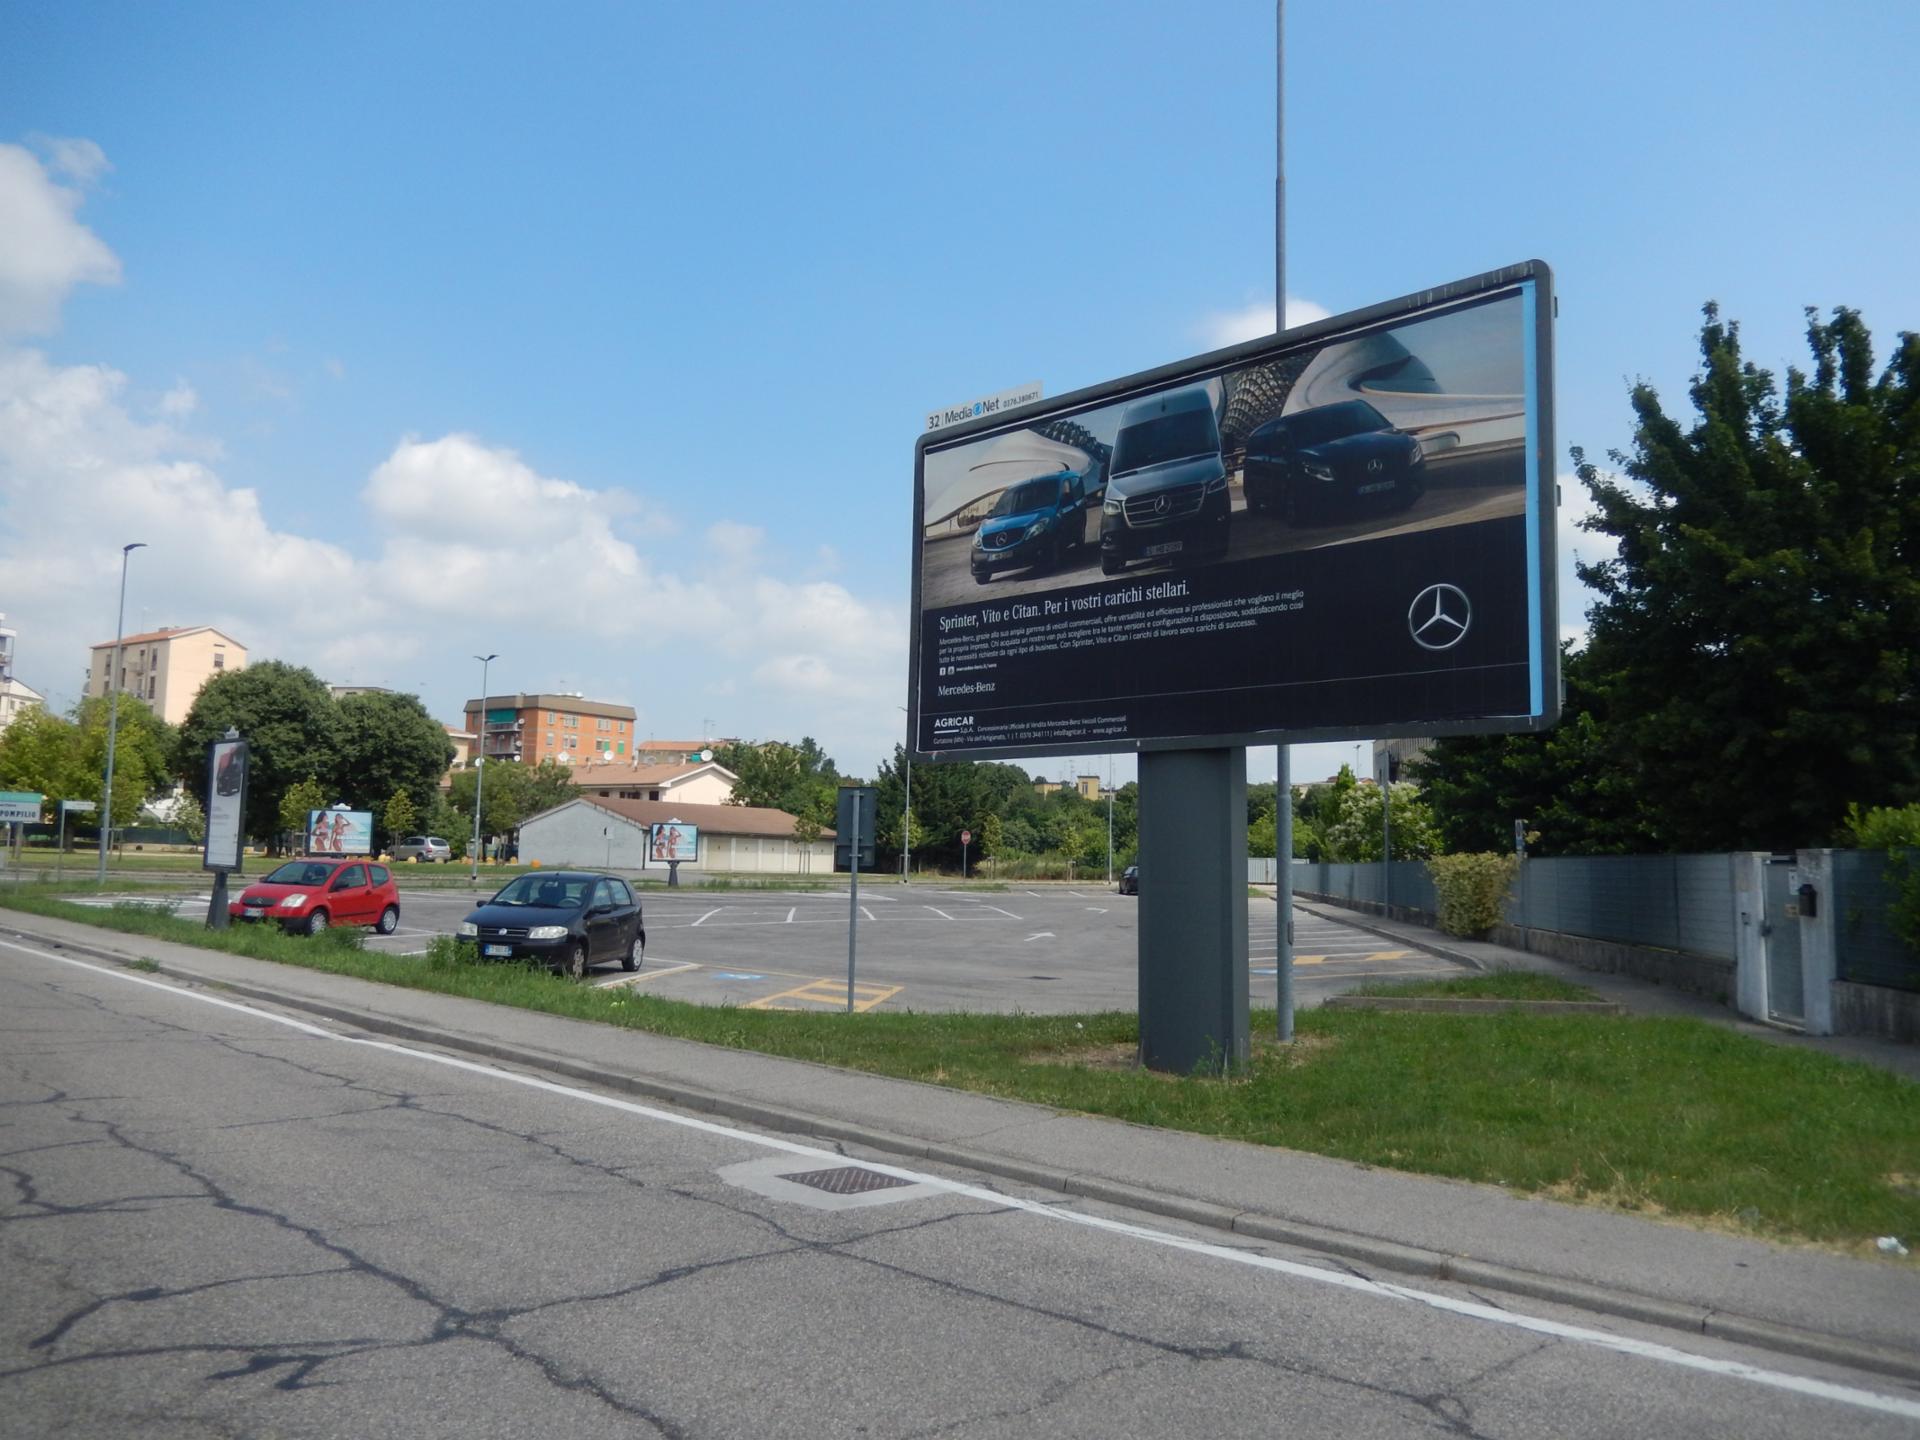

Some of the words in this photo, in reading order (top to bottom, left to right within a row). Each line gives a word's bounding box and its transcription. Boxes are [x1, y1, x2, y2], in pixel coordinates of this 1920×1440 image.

[928, 415, 940, 429] 32
[940, 614, 979, 632] Sprinter,
[982, 609, 1000, 624] Vito
[1004, 609, 1010, 620] e
[1012, 604, 1040, 620] Citan.
[1044, 600, 1062, 614] Per
[1064, 598, 1068, 612] i
[1072, 593, 1101, 610] vostri
[1105, 587, 1142, 606] carichi
[1146, 580, 1190, 600] stellari.
[1146, 609, 1154, 618] ed
[1234, 597, 1246, 606] che
[1248, 594, 1274, 606] vogliono
[1281, 590, 1304, 600] meglio
[1124, 620, 1145, 630] versioni
[1060, 640, 1071, 648] Con
[1072, 637, 1094, 648] Sprinter,
[1096, 635, 1107, 644] Vito
[1113, 633, 1128, 642] Citan
[1154, 628, 1159, 636] di
[1160, 628, 1178, 636] lavoro
[1180, 626, 1194, 634] sono
[1196, 622, 1216, 632] carichi
[1218, 621, 1224, 630] di
[1226, 618, 1257, 629] successo.
[938, 682, 996, 696] Mercedes-Benz
[934, 716, 974, 728] AGRICAR
